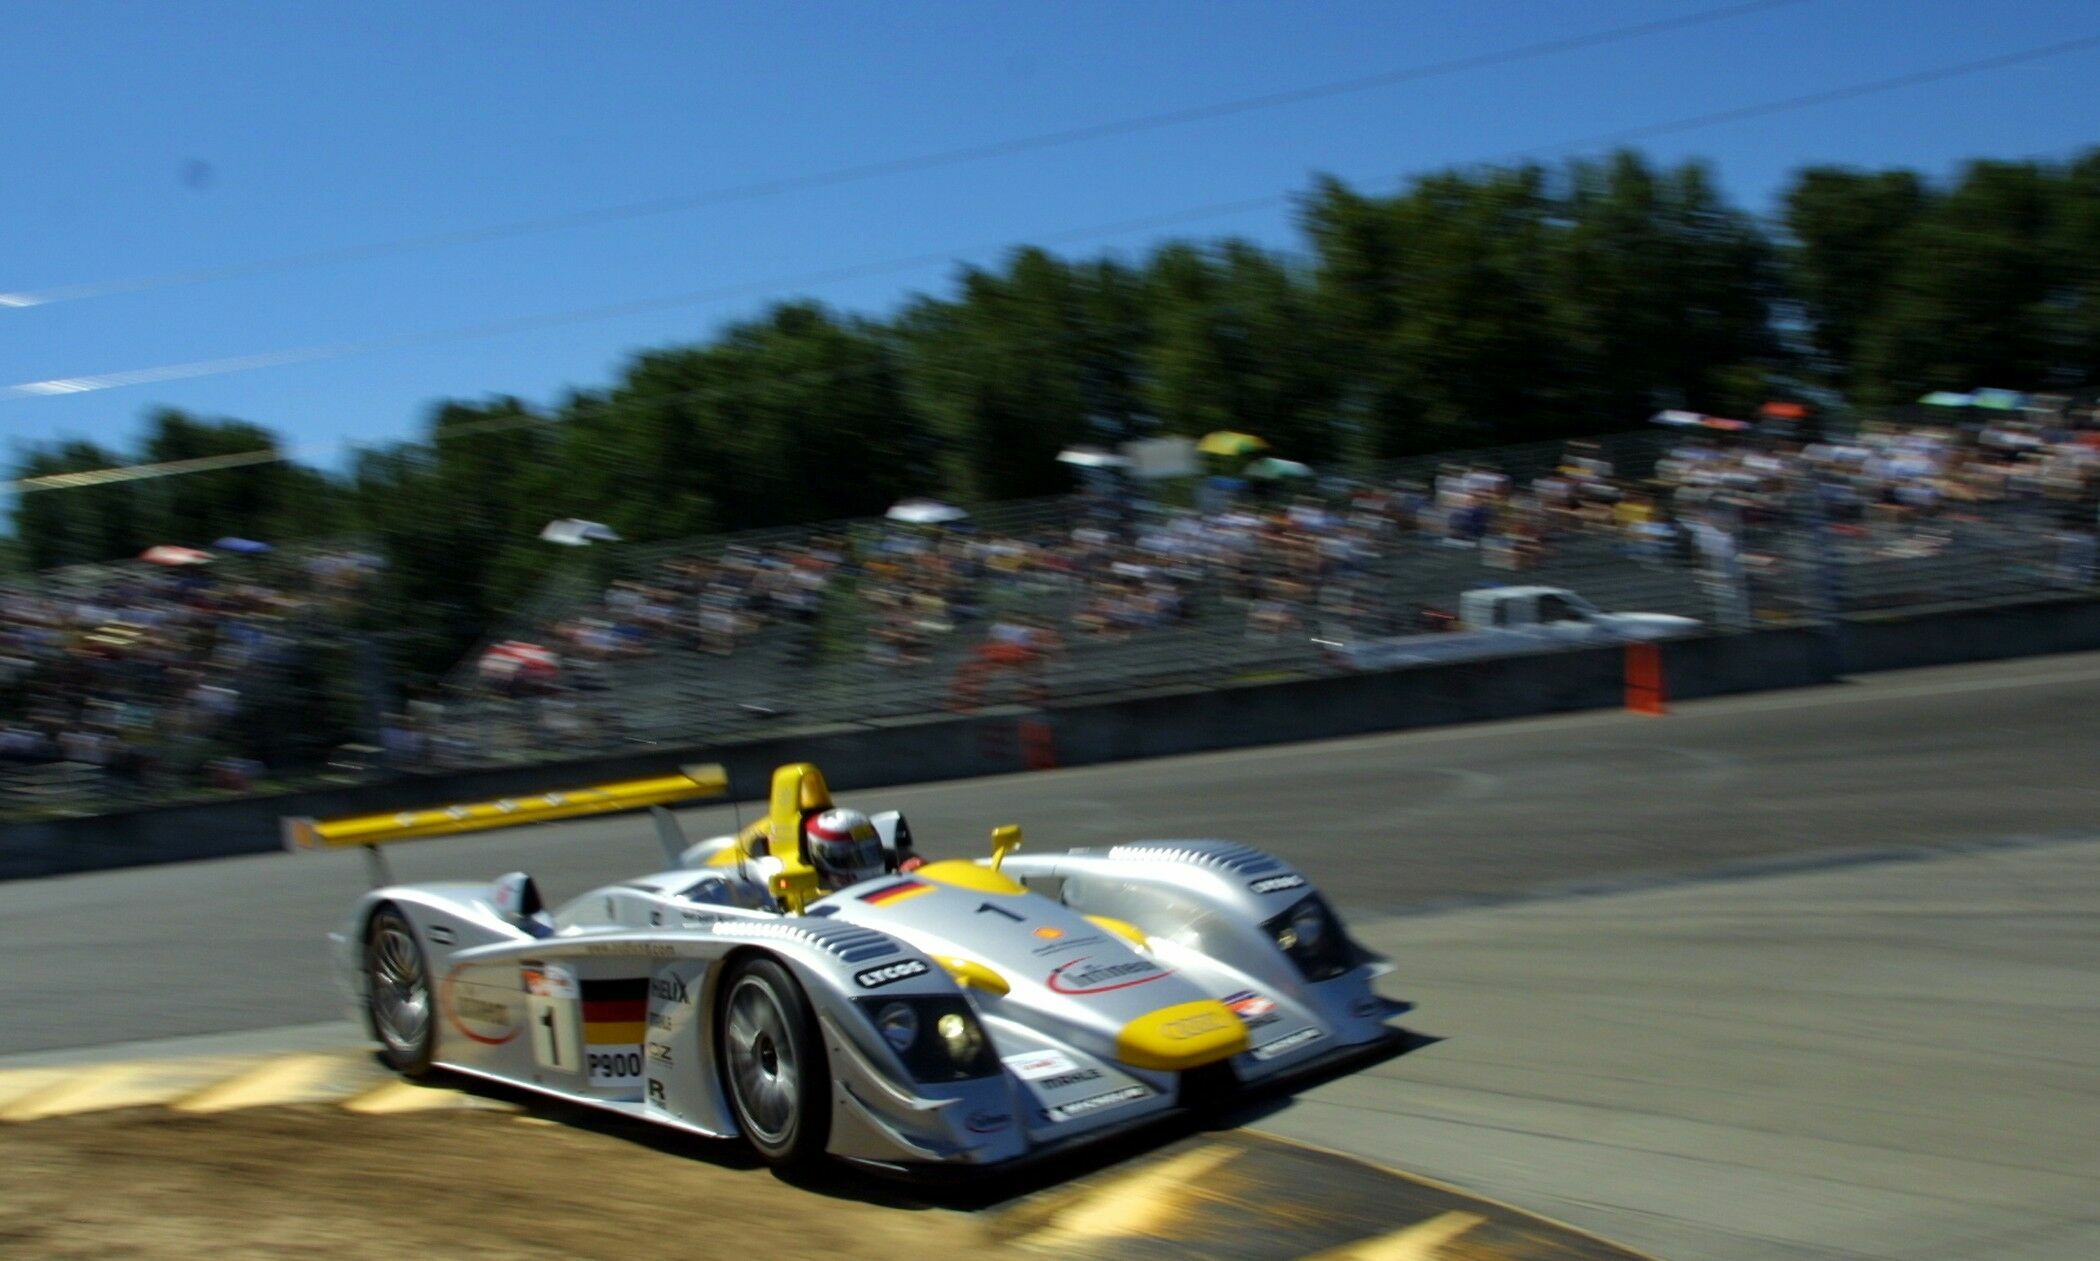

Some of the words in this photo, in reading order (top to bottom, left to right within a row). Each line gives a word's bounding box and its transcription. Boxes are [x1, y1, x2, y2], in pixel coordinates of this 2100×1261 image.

[976, 902, 1026, 921] 1
[859, 961, 925, 986] LYCOS
[541, 1006, 561, 1066] 1
[588, 1053, 641, 1077] P900
